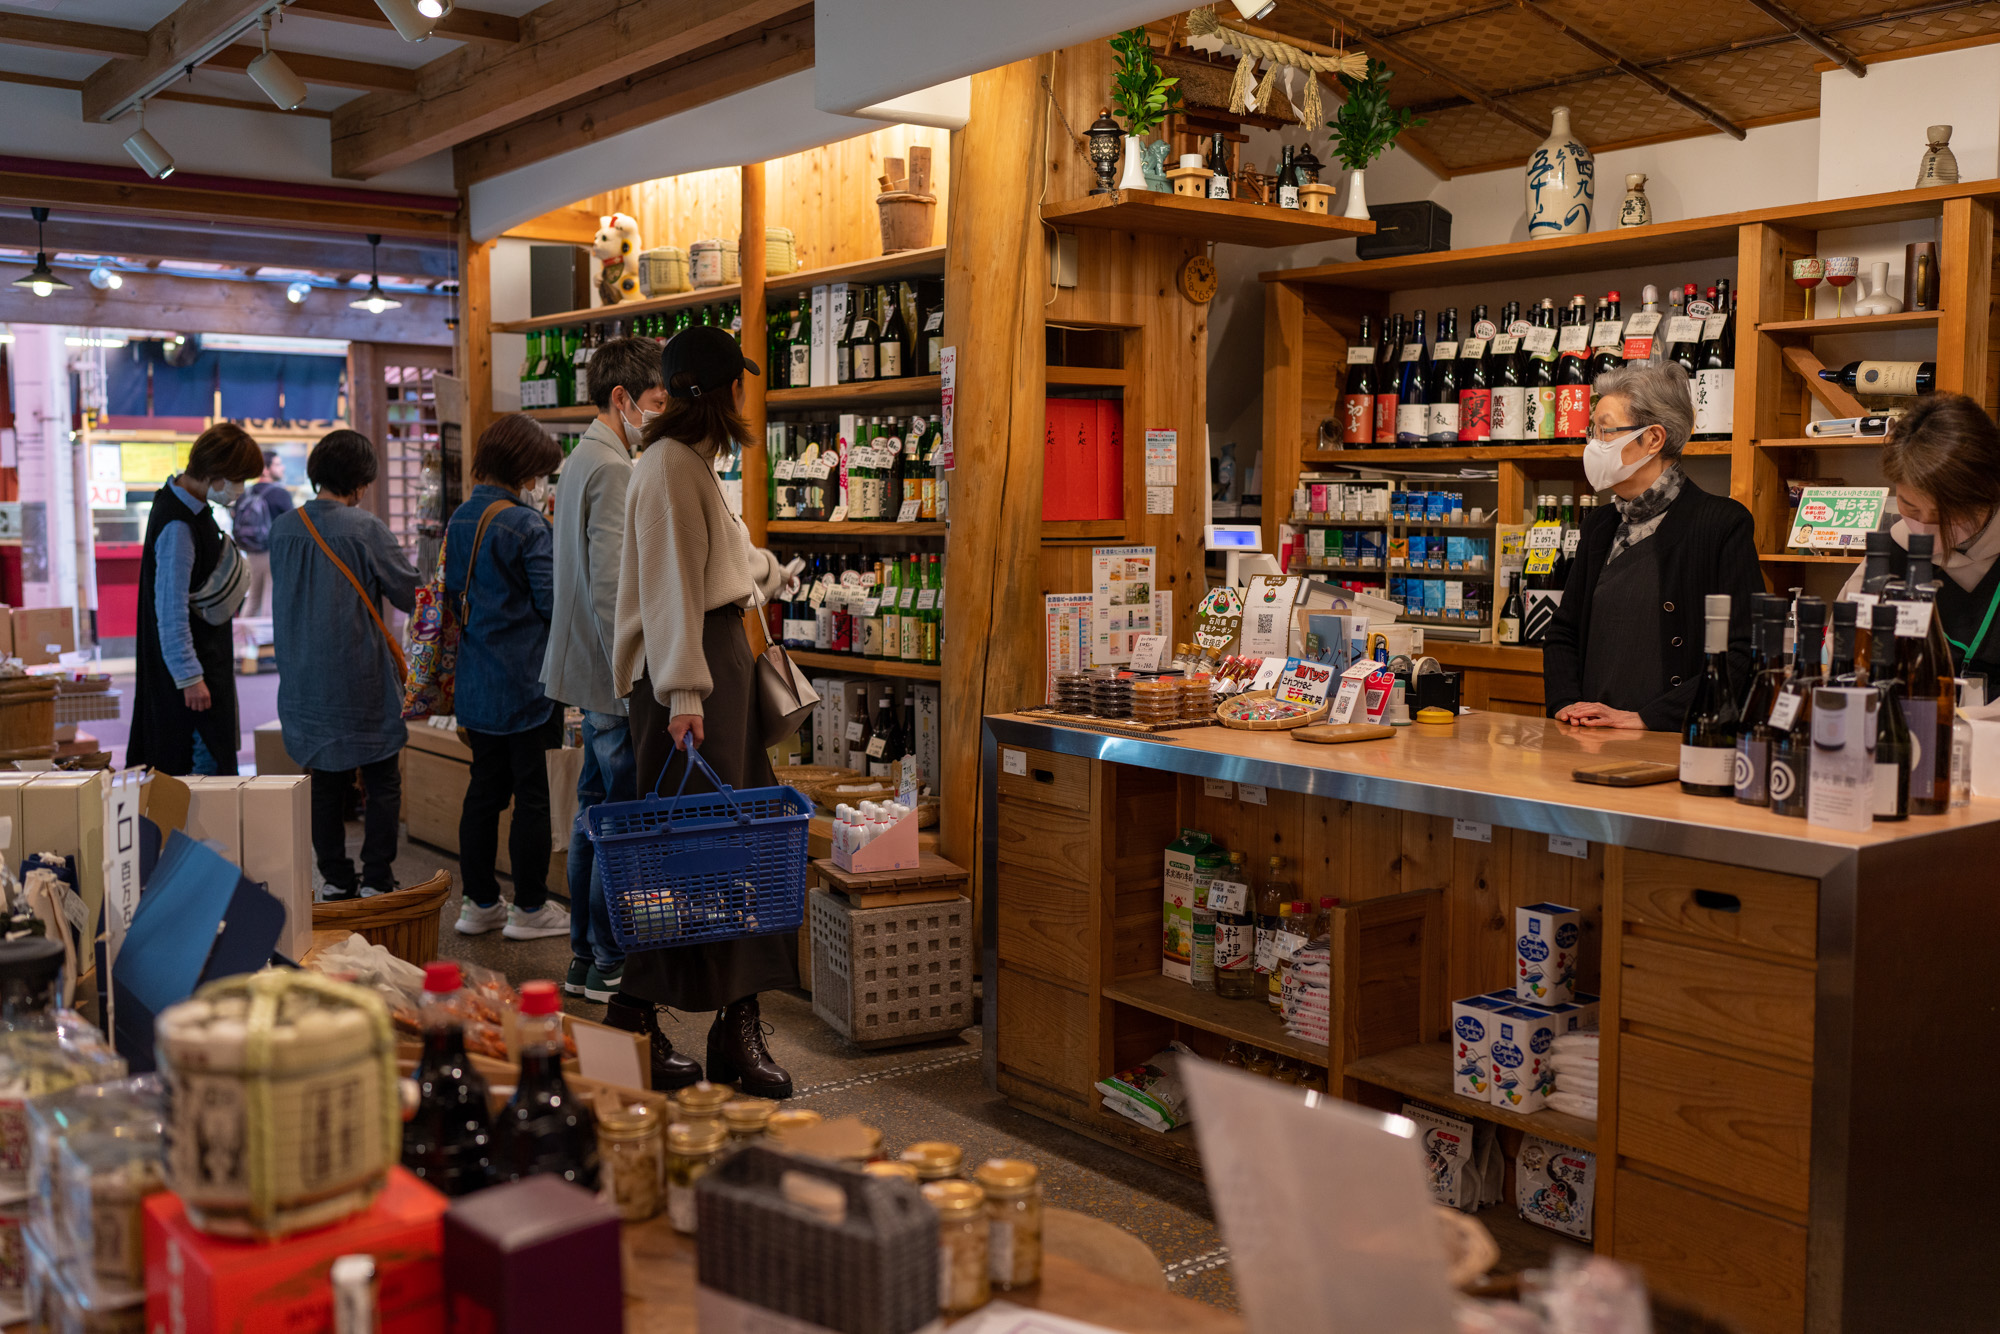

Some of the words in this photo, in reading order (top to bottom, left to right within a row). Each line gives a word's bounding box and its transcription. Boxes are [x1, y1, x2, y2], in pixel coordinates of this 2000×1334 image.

[1206, 260, 1209, 268] 1
[1188, 266, 1196, 274] 10
[1209, 266, 1215, 275] 2
[1189, 282, 1194, 291] 8
[1209, 283, 1216, 292] 4
[1199, 291, 1204, 300] 6
[1205, 290, 1210, 299] 5
[1526, 394, 1537, 432] 天狗舞
[90, 486, 121, 504] 入口
[1834, 499, 1879, 510] 減らそう
[1831, 510, 1875, 528] レジ袋
[1208, 617, 1227, 625] 石川県
[1199, 624, 1232, 633] 観光クーポン
[1202, 637, 1222, 648] 取扱店
[1295, 665, 1329, 683] 酒バッジ
[1282, 678, 1312, 690] これつけると
[920, 695, 931, 714] 梵
[1165, 868, 1194, 884] 果実酒の季節
[1216, 895, 1228, 904] 847
[1216, 927, 1241, 964] 料理酒
[1518, 937, 1548, 954] Cooking
[1529, 950, 1544, 960] Salt
[1455, 1019, 1484, 1036] Cooking
[1465, 1030, 1480, 1041] Salt
[1492, 1044, 1523, 1060] Cooking
[1502, 1055, 1518, 1067] Salt
[1440, 1133, 1457, 1142] にがり
[1433, 1139, 1460, 1157] 食塩
[1560, 1165, 1586, 1184] 食塩
